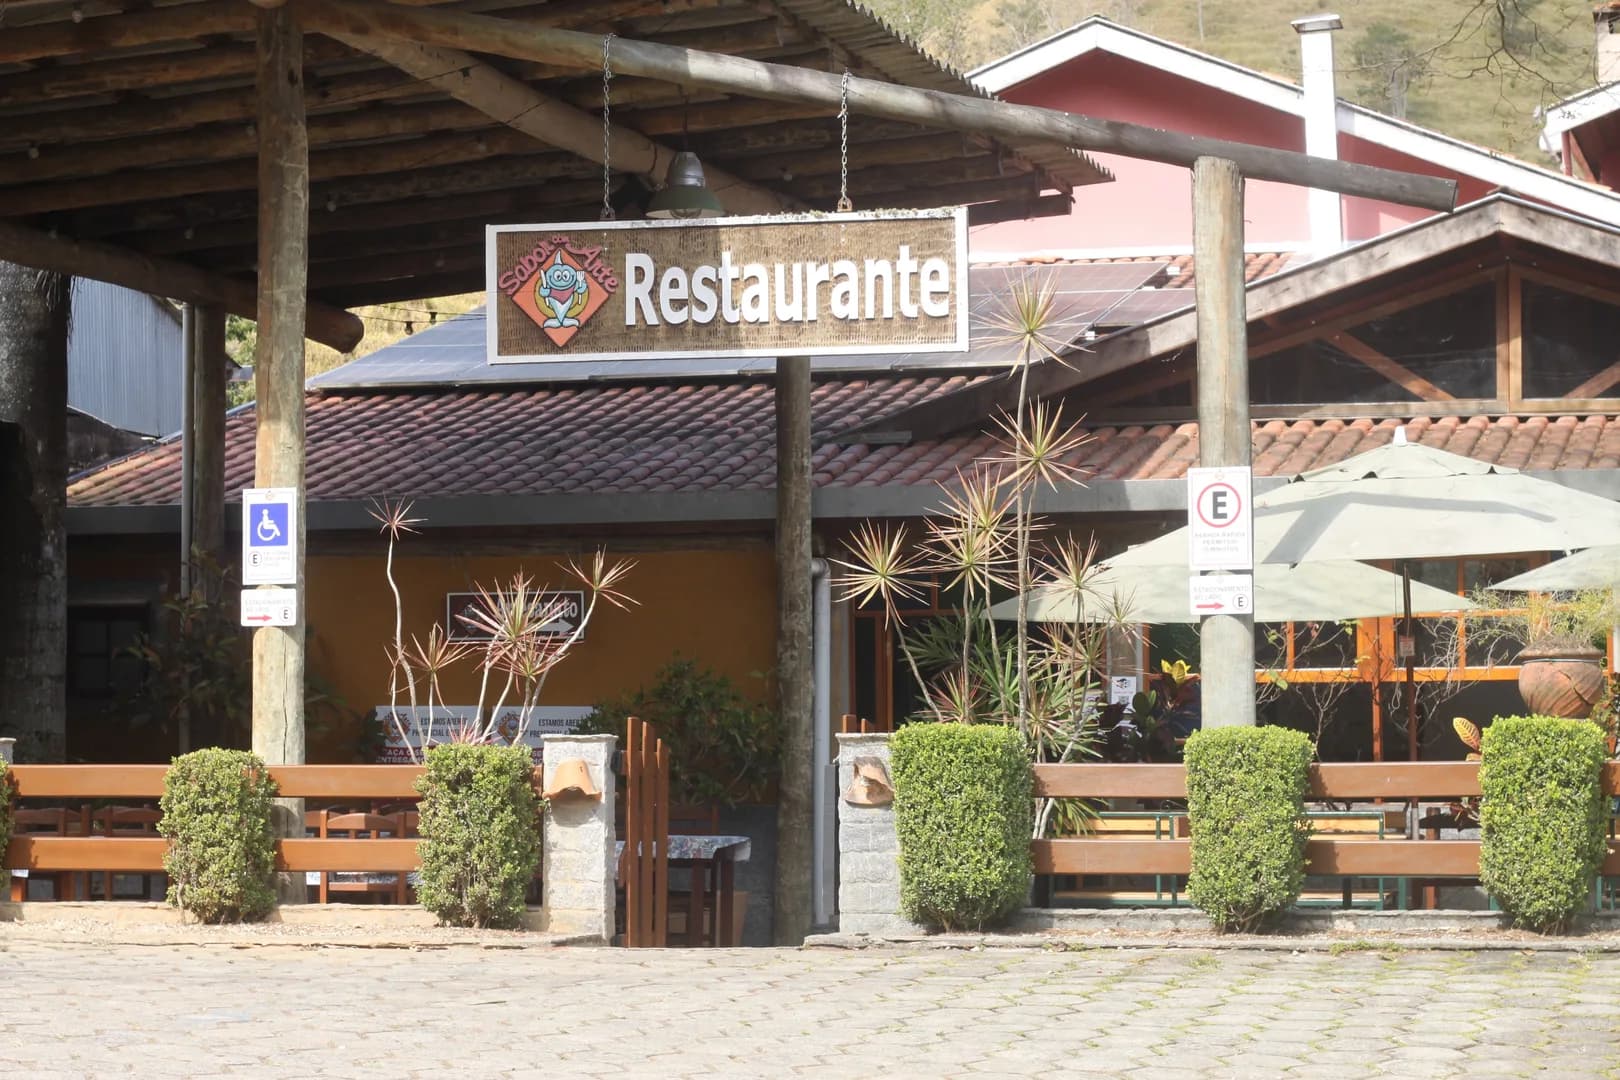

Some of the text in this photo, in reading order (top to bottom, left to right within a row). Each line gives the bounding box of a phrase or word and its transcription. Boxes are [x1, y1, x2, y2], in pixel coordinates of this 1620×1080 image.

[624, 245, 951, 327] Restaurante
[1212, 491, 1228, 519] E
[252, 553, 259, 564] E
[1237, 596, 1245, 608] E
[283, 608, 289, 620] E
